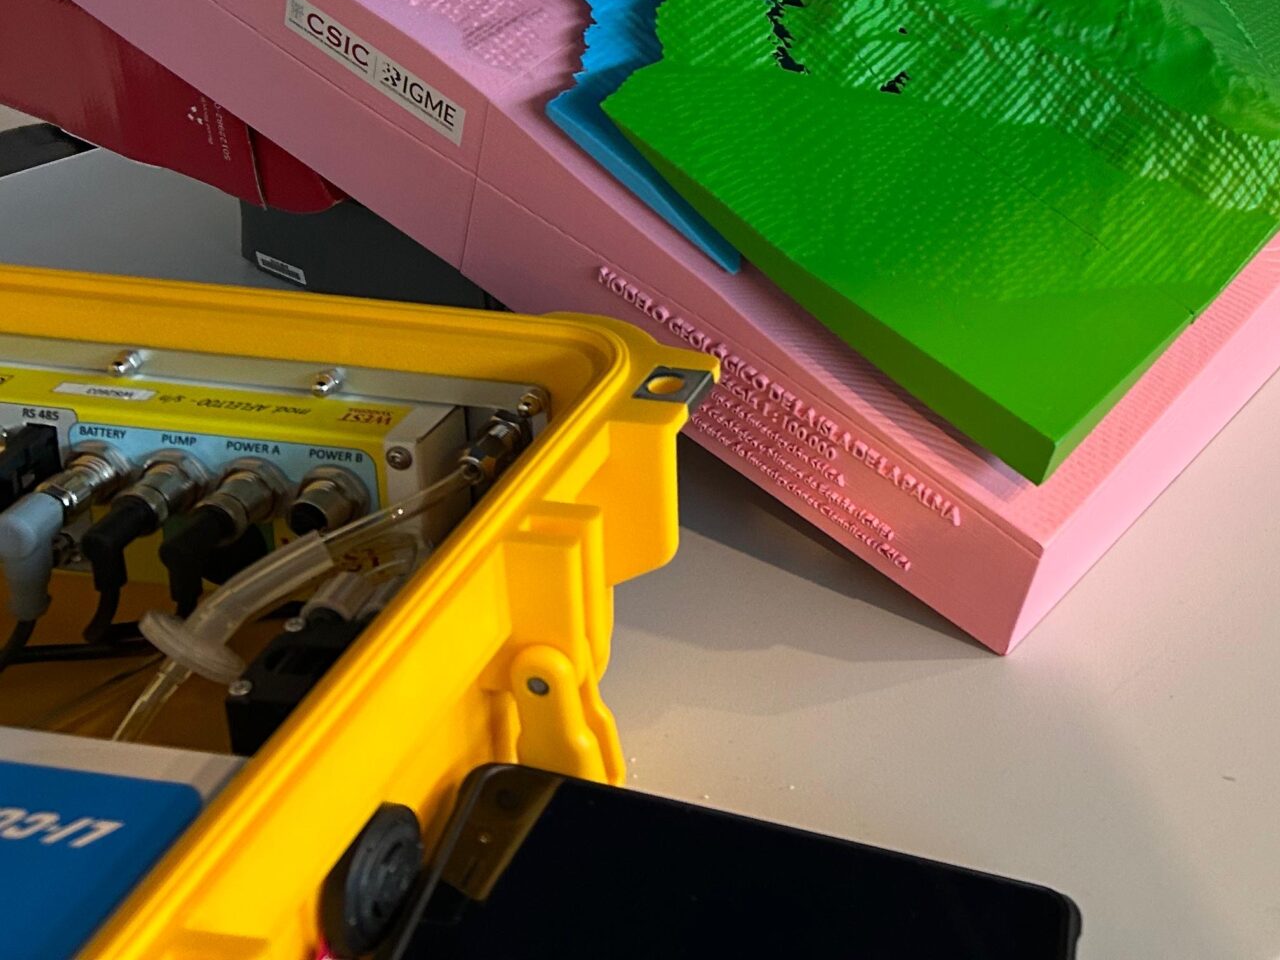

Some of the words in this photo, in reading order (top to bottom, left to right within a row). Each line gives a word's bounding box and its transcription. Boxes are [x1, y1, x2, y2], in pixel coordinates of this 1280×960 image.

[306, 12, 371, 67] CSIC
[402, 75, 457, 127] IGME
[598, 265, 670, 324] MODELO
[669, 316, 770, 392] GEOLÓGICO
[769, 382, 796, 410] DE
[793, 399, 817, 427] LA
[816, 415, 852, 452] ISLA
[852, 440, 880, 470] DE
[877, 456, 901, 486] LA
[902, 472, 962, 527] PALMA
[22, 407, 37, 418] RS
[38, 409, 60, 421] 485
[79, 425, 127, 440] BATTERY
[161, 433, 198, 447] PUMP
[782, 414, 838, 461] 100.000
[225, 440, 270, 455] POWER
[271, 445, 281, 456] A
[309, 447, 353, 462] POWER
[354, 451, 364, 464] B
